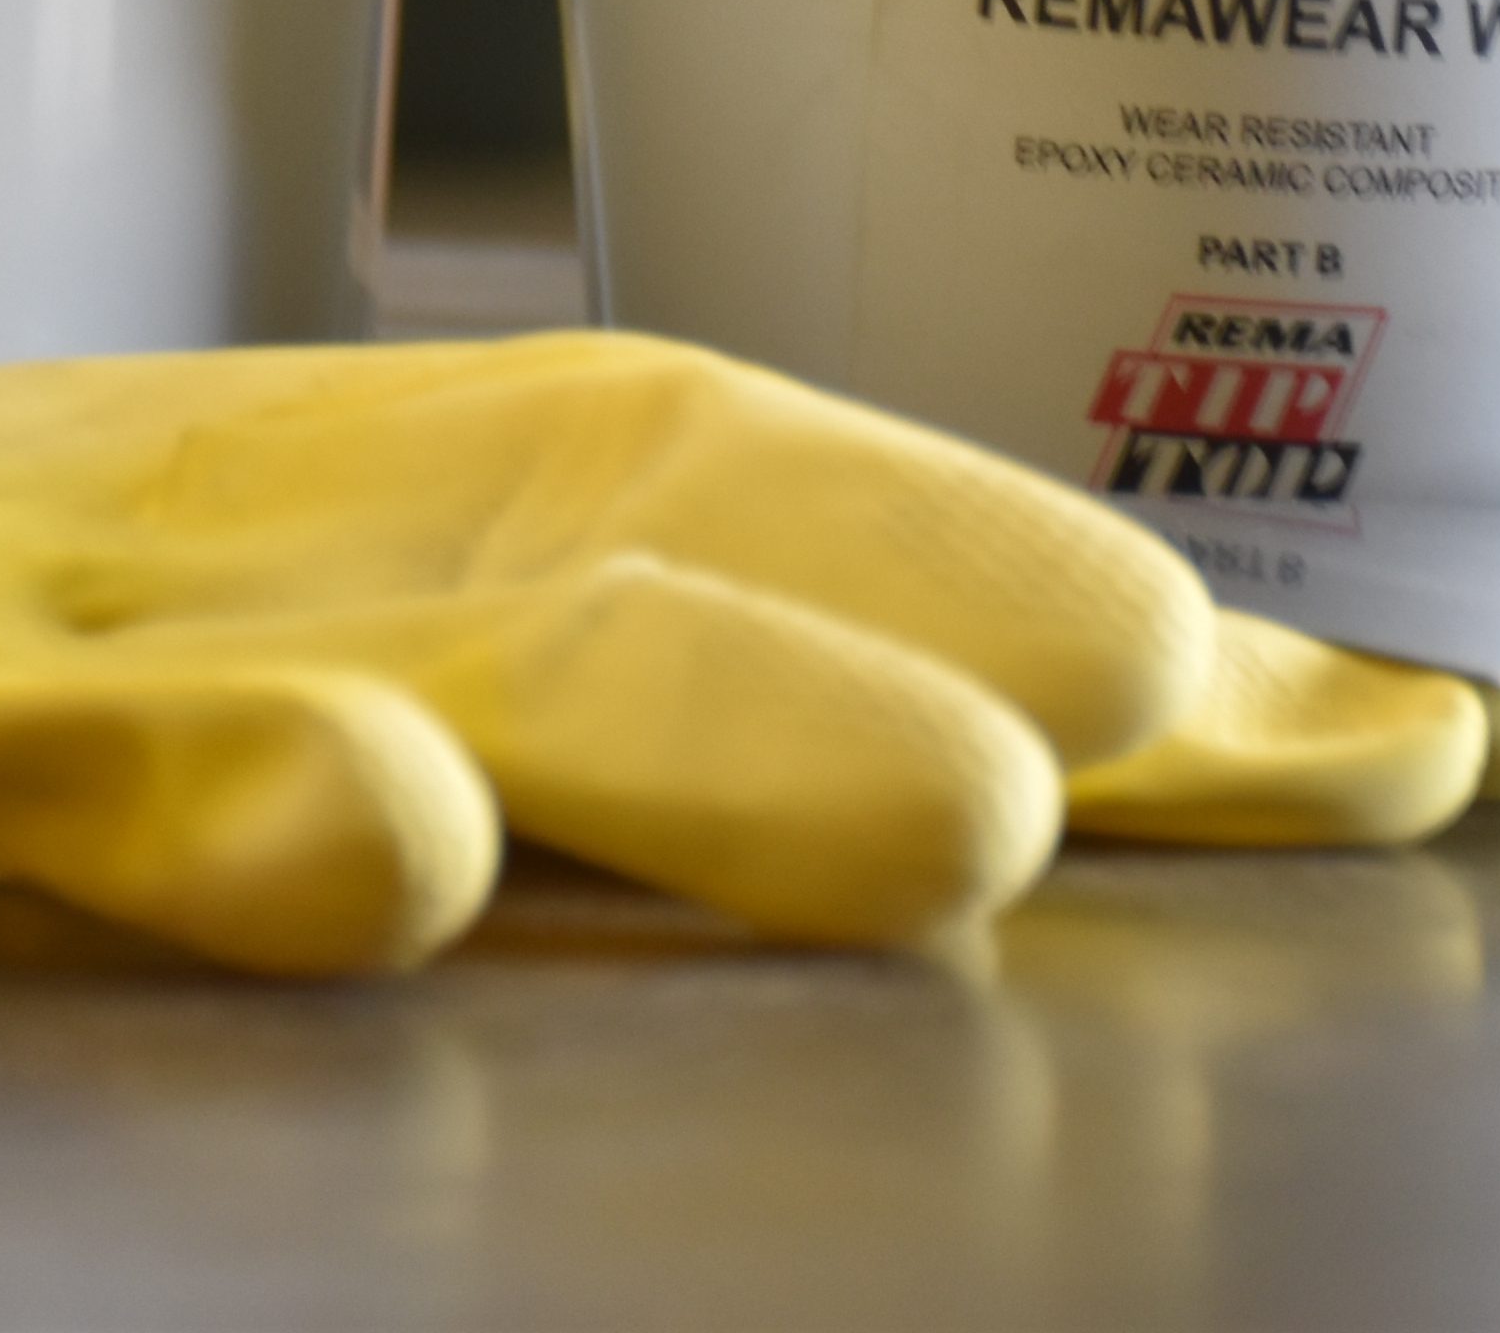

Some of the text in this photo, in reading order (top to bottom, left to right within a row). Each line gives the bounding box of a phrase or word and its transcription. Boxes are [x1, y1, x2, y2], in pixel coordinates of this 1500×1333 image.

[1120, 103, 1436, 158] WEAR RESISTANT
[1016, 135, 1135, 182] EPOXY
[1146, 151, 1313, 195] CERAMIC
[1199, 235, 1344, 278] PART B
[1174, 311, 1354, 356] REMA
[1115, 357, 1332, 431] TIP
[1125, 433, 1347, 501] TOP
